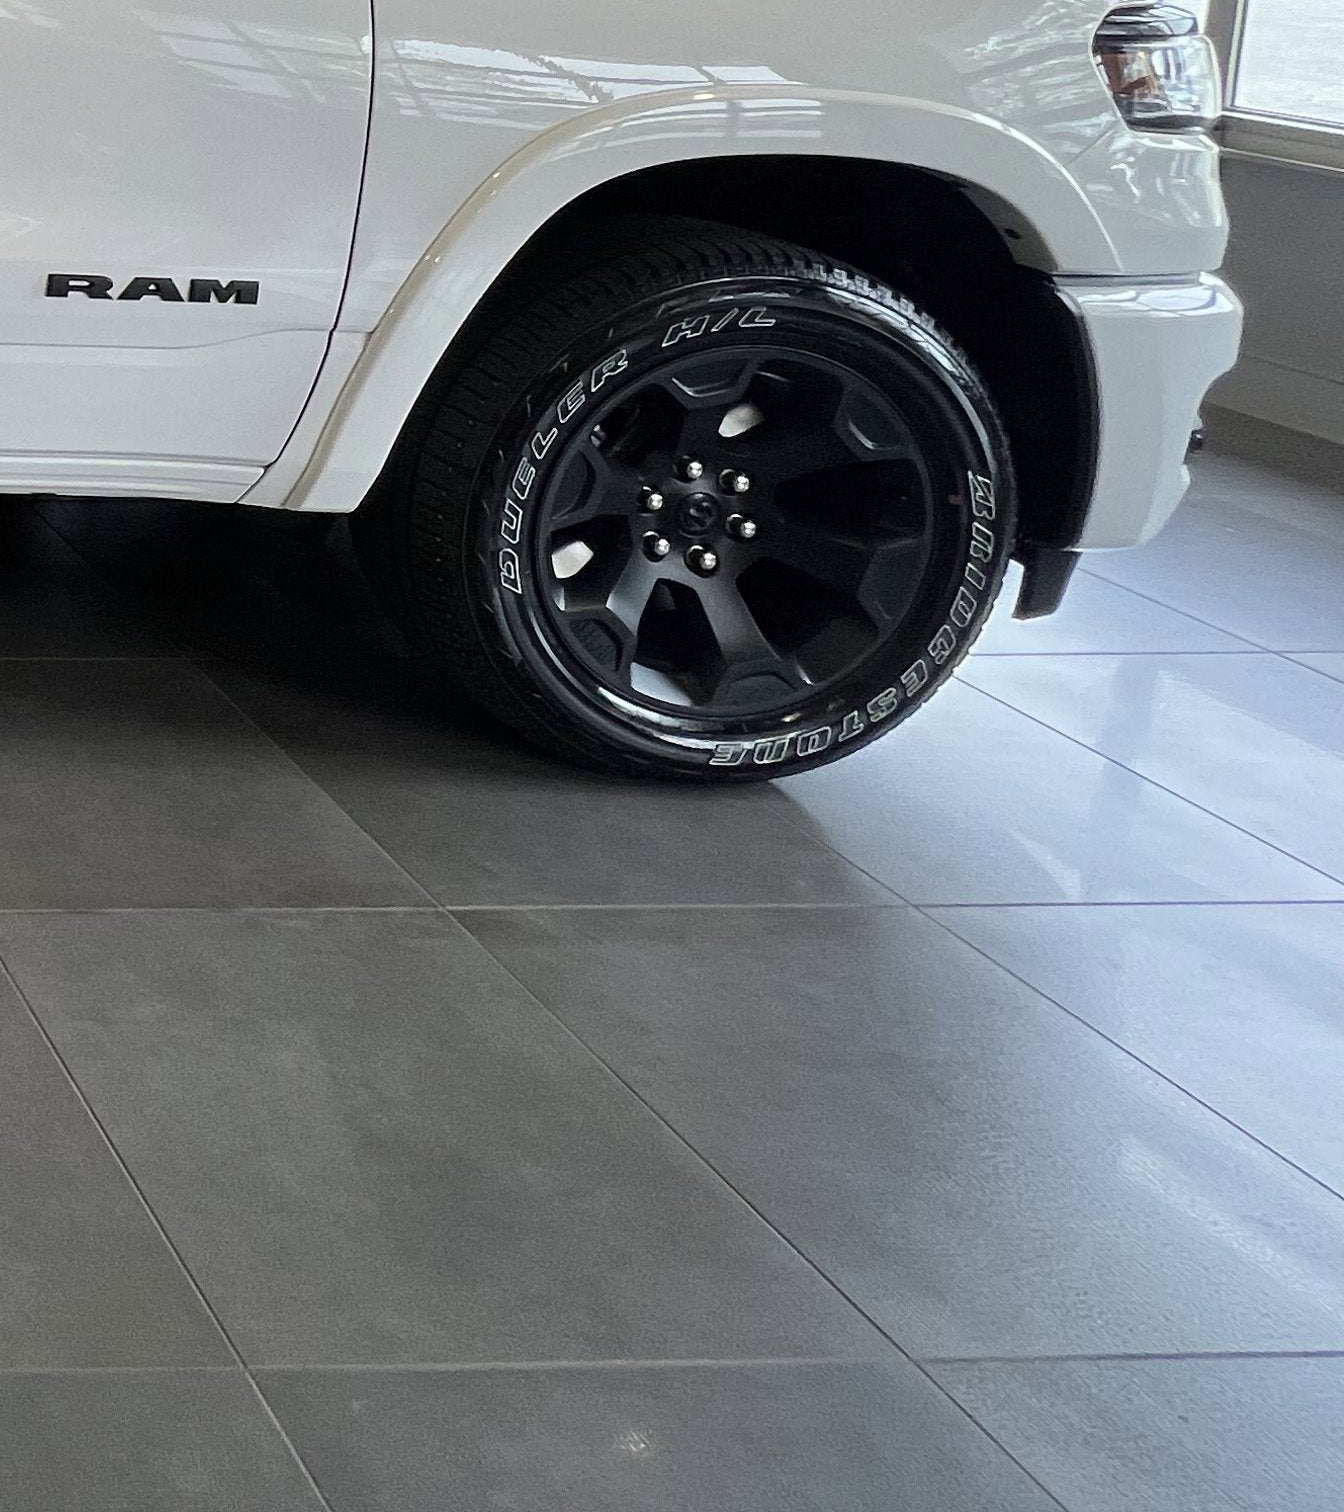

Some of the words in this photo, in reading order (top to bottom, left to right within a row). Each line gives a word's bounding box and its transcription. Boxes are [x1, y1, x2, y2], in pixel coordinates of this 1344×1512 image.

[44, 273, 261, 306] RAM
[498, 349, 629, 595] DUELER
[661, 306, 776, 348] H/L
[708, 463, 997, 767] BRIDGESTONE
